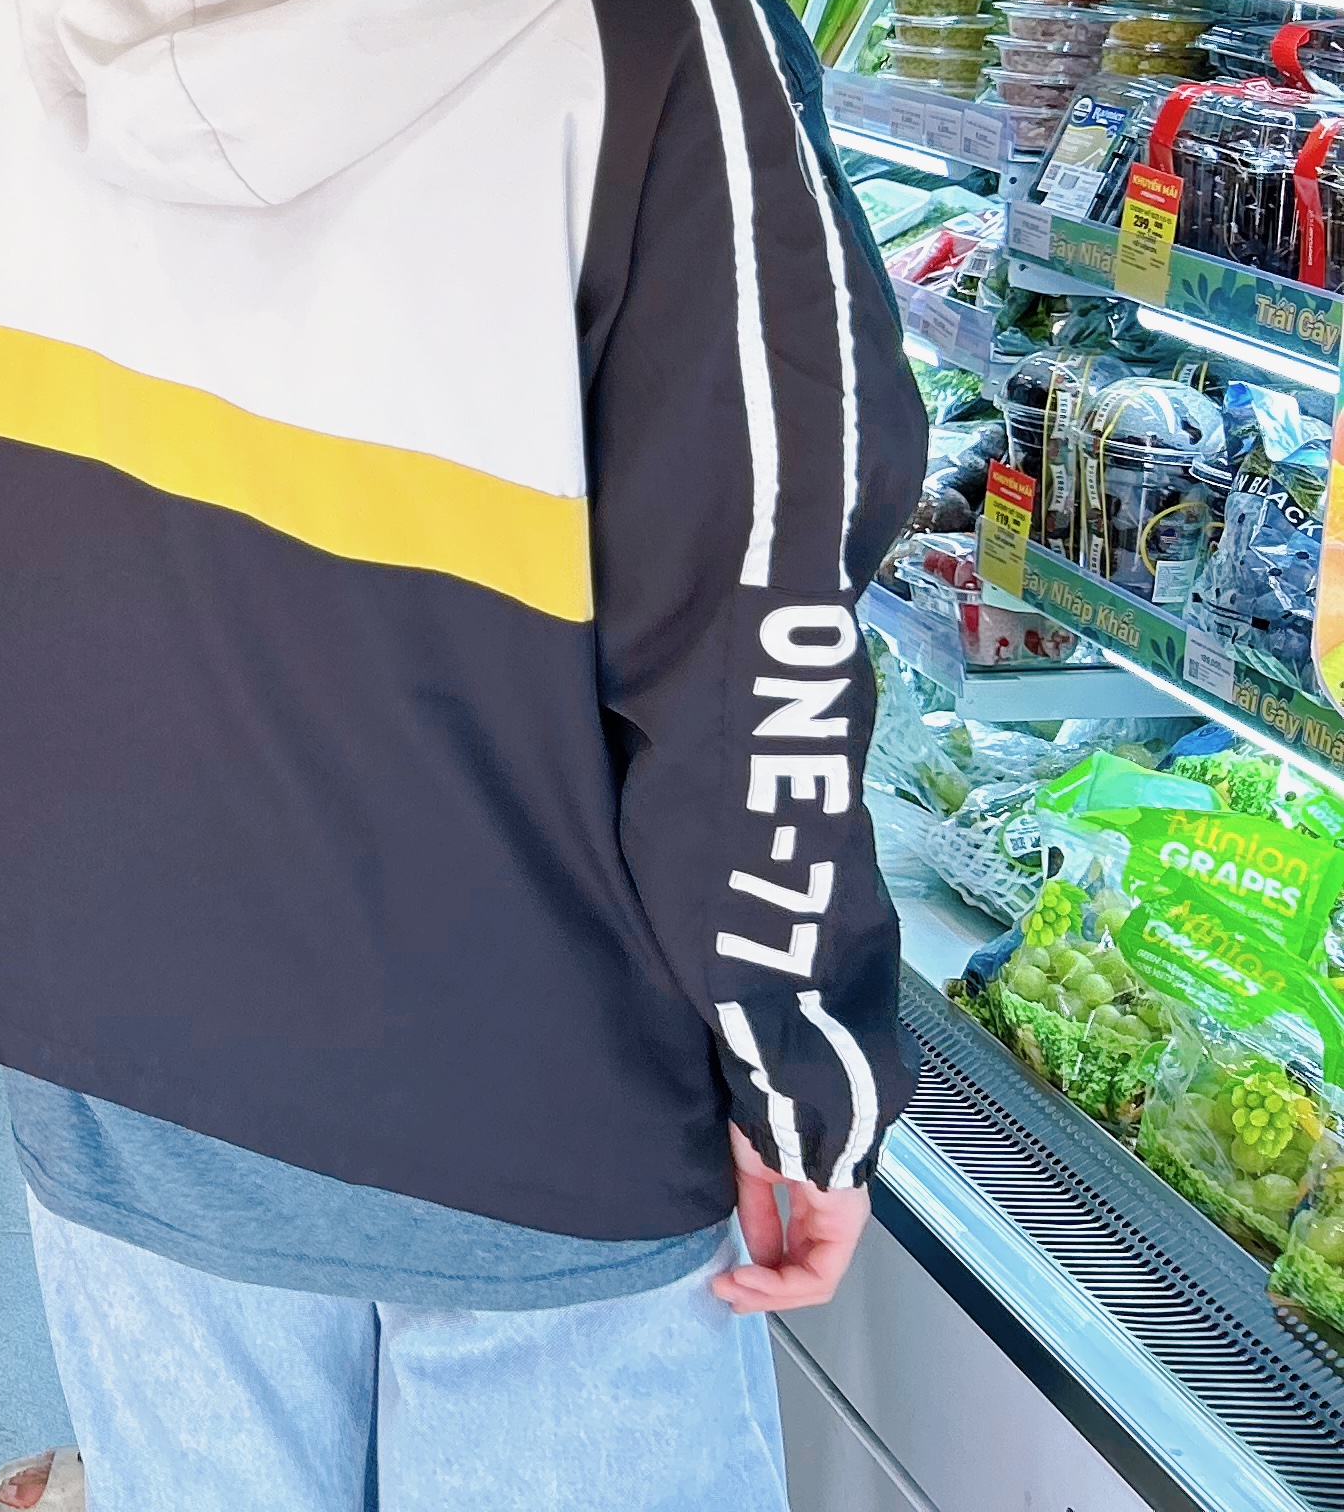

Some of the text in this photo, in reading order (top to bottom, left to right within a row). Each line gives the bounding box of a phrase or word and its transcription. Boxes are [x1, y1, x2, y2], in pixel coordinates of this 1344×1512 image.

[1255, 293, 1340, 354] Trái Cây
[1247, 476, 1324, 537] BLACK
[1051, 579, 1093, 624] Nhập
[1097, 606, 1141, 651] Khẩu
[1233, 676, 1344, 767] rái Cây Nhậ
[716, 605, 858, 977] ONE-77
[1159, 841, 1302, 919] GRAPES
